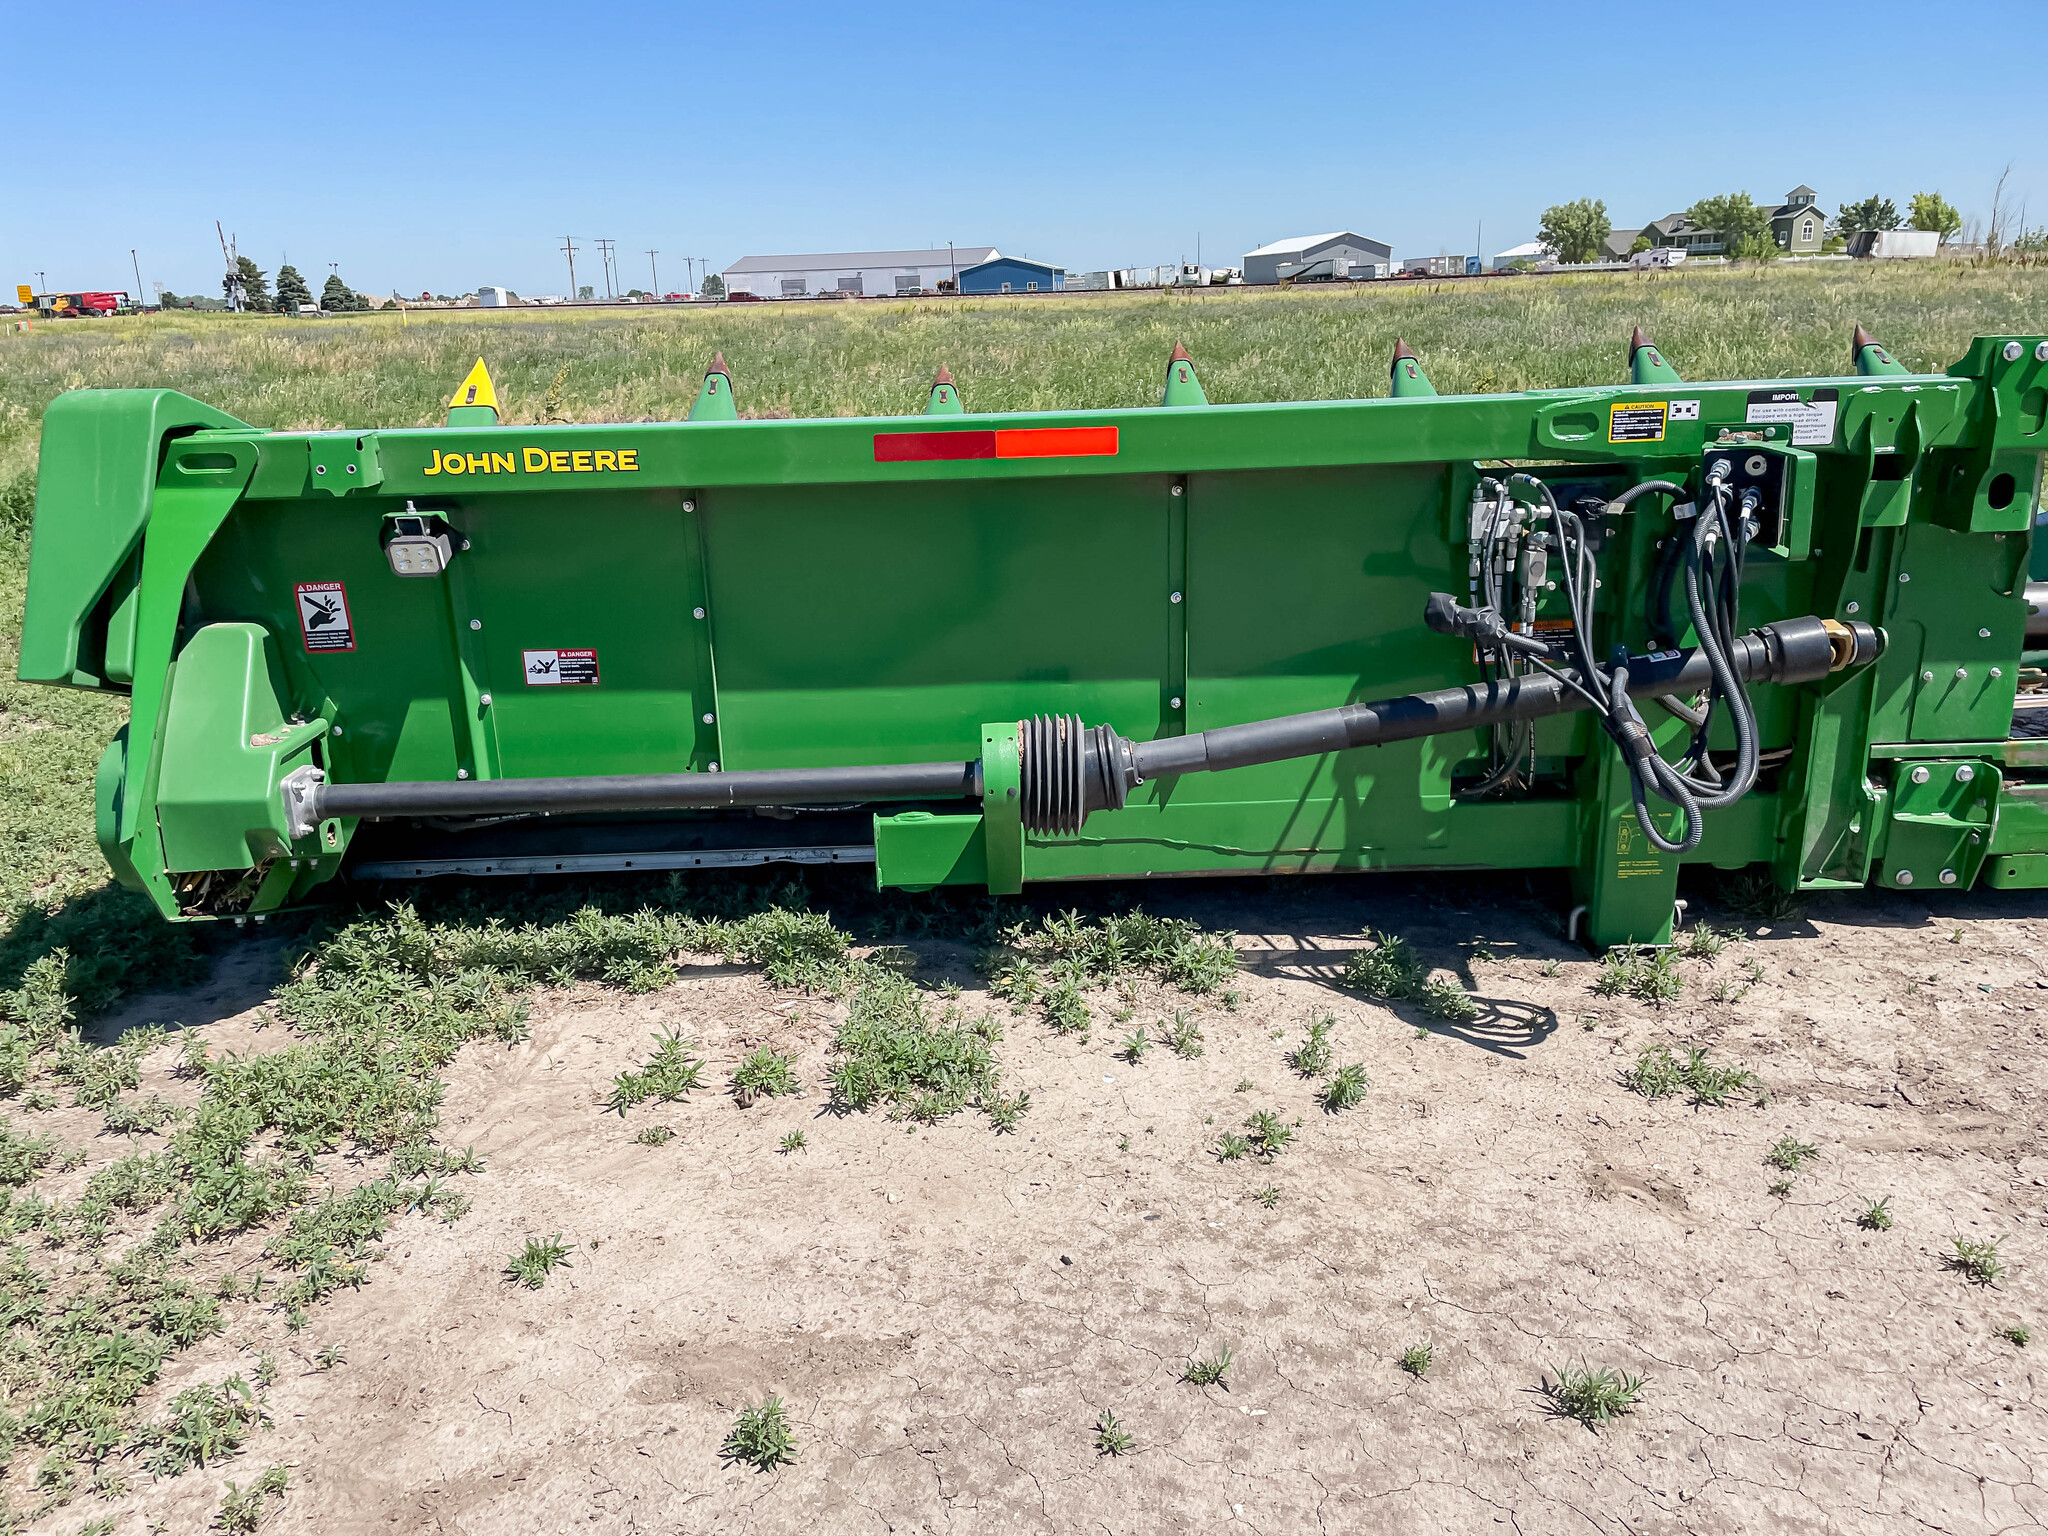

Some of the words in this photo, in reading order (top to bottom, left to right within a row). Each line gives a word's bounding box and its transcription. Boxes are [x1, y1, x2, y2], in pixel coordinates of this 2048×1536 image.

[422, 449, 517, 476] JOHN
[521, 447, 640, 474] DEERE
[306, 583, 341, 591] DANGER
